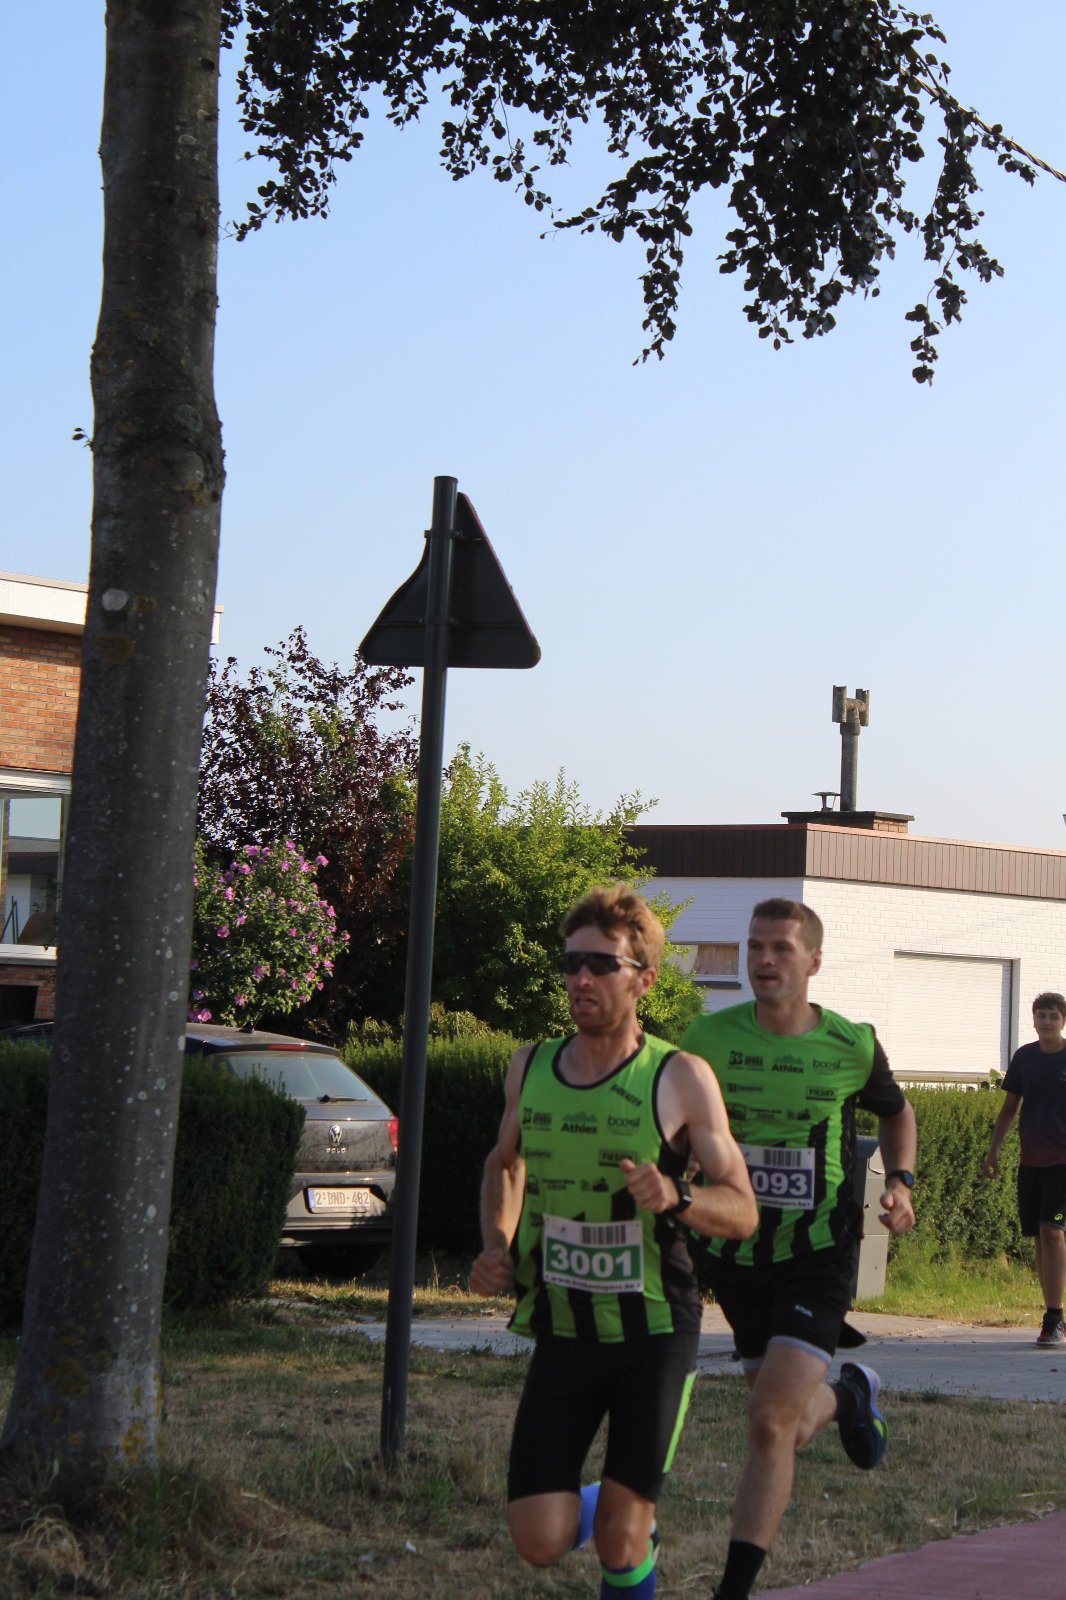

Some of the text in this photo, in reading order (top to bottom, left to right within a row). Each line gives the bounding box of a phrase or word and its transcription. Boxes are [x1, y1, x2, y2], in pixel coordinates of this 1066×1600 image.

[772, 1063, 804, 1074] Athlex
[560, 1122, 598, 1134] Athlex
[752, 1170, 808, 1196] 093
[550, 1243, 632, 1278] 3001
